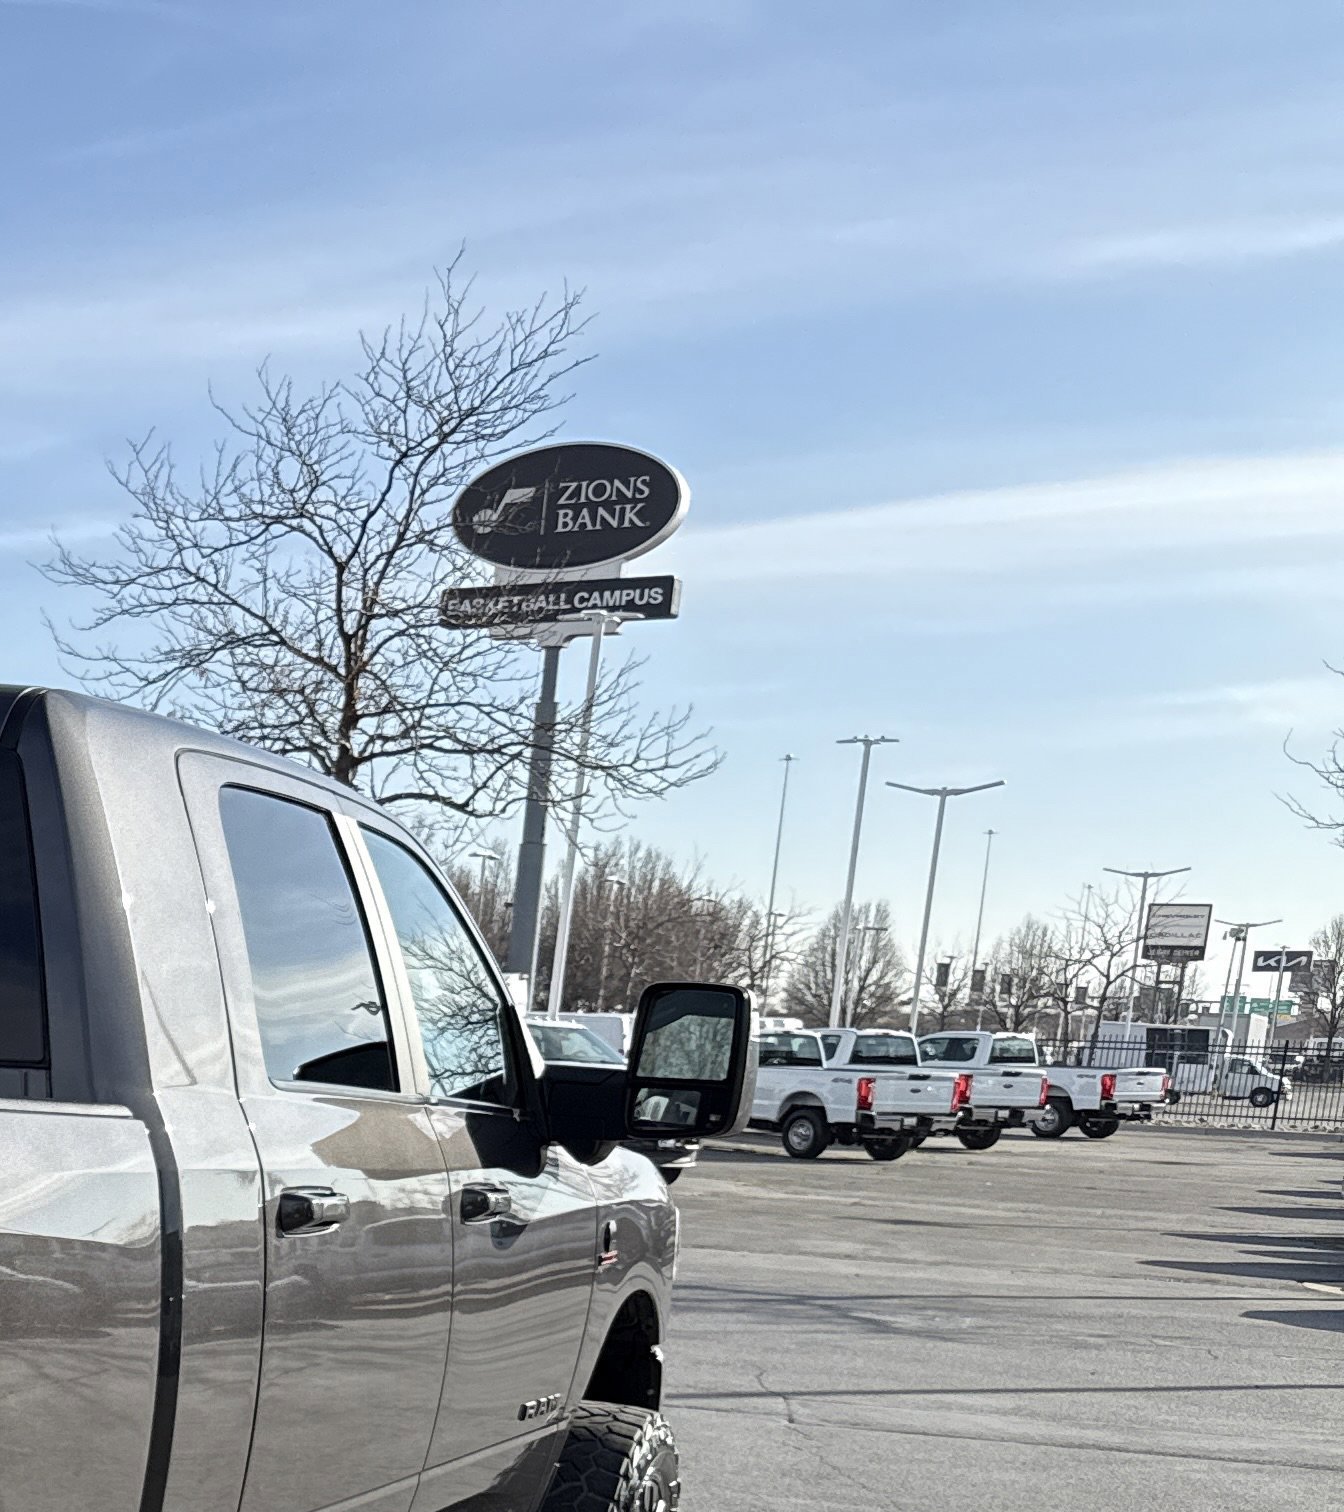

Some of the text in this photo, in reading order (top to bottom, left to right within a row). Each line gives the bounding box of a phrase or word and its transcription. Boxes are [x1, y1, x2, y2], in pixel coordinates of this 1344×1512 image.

[558, 475, 650, 504] ZIONS
[555, 503, 647, 534] BANK
[573, 586, 664, 609] CAMPUS
